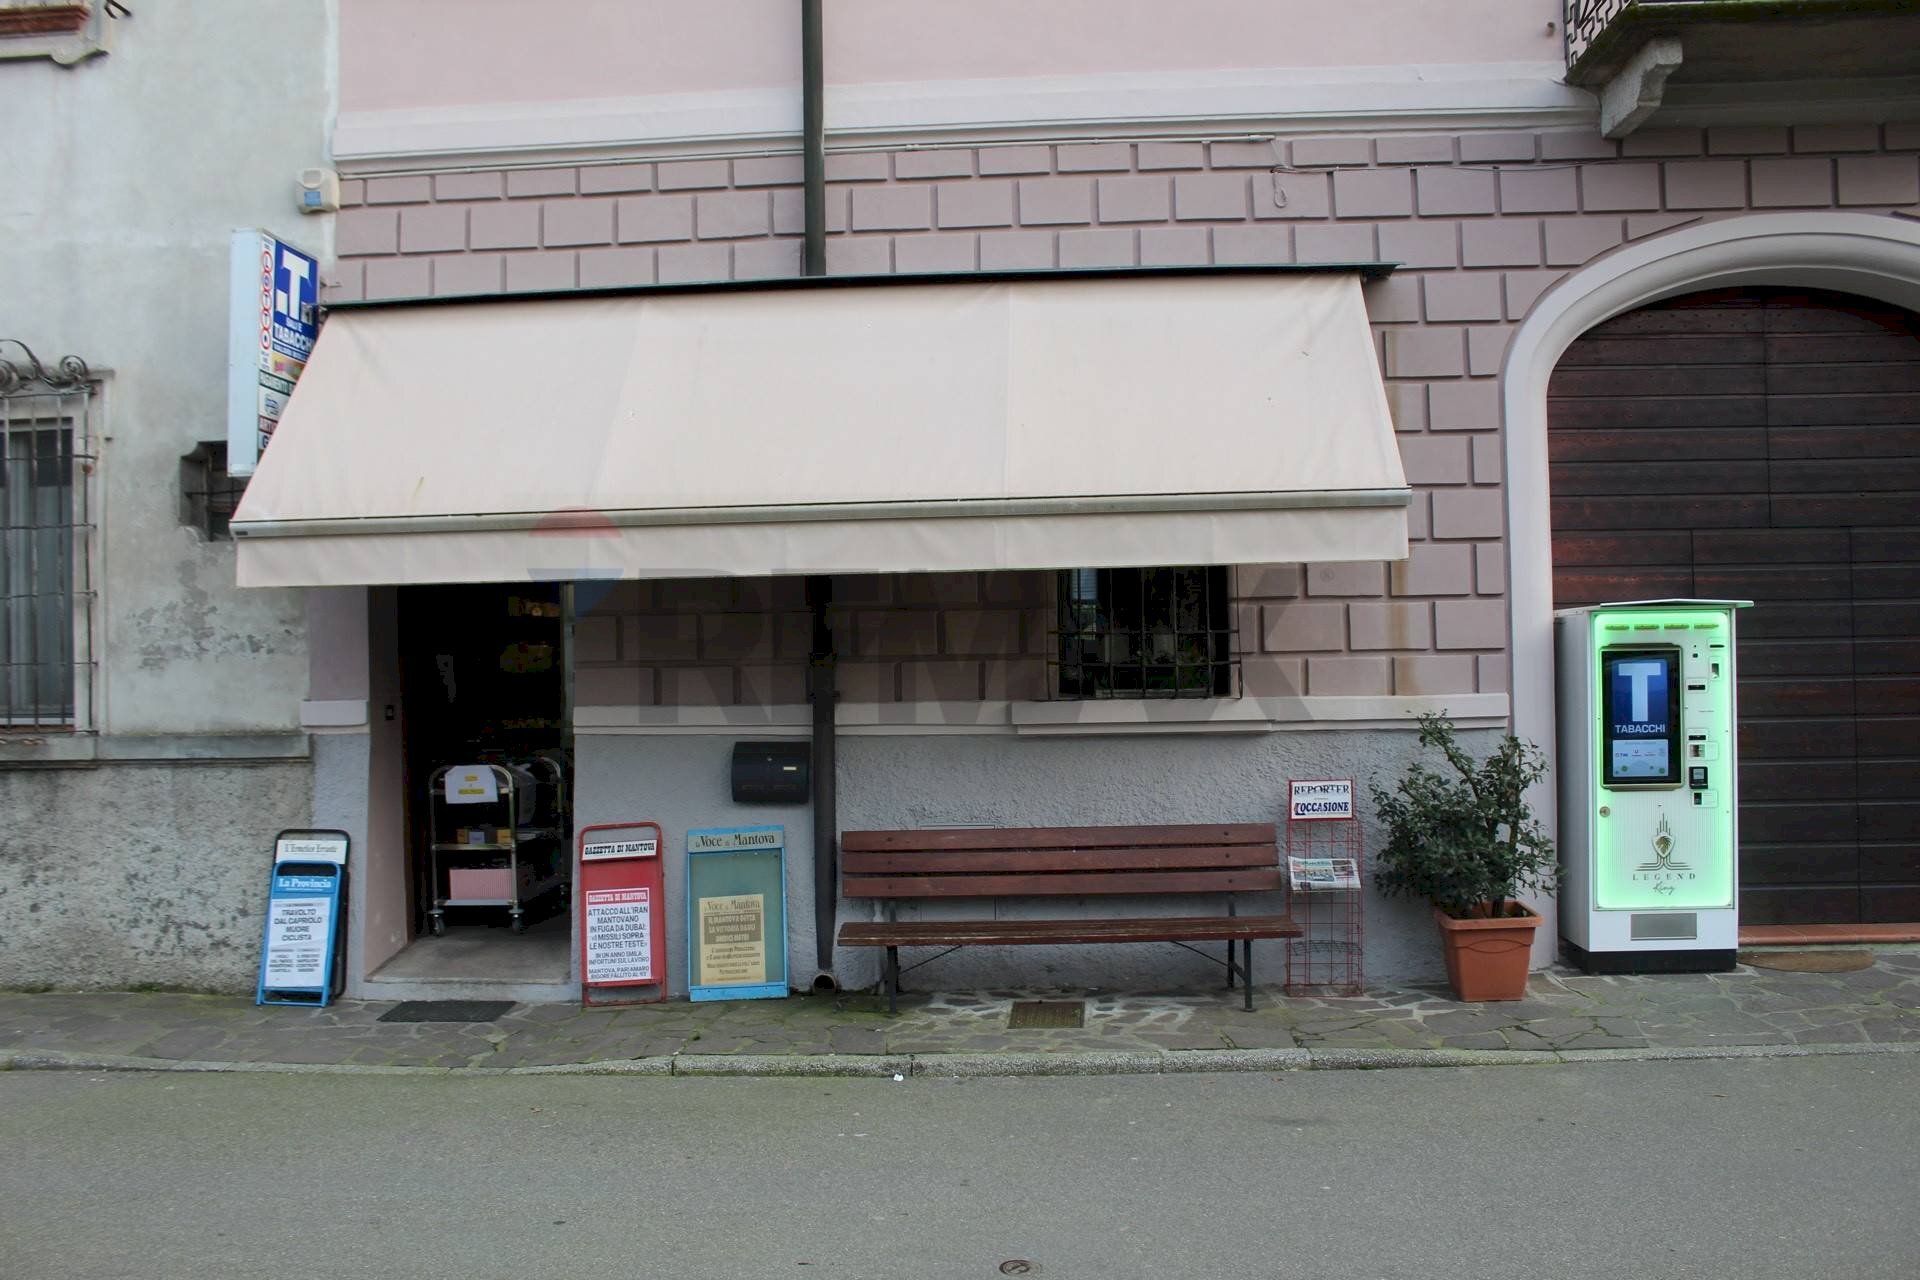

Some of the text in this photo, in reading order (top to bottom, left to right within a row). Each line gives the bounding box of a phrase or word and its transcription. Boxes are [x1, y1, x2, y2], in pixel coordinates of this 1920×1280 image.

[281, 248, 310, 321] T
[274, 322, 312, 351] TABACCH
[1618, 663, 1661, 722] T
[1614, 724, 1666, 734] TABACCHI
[1294, 784, 1350, 796] REPORTER
[700, 835, 722, 847] Voce
[734, 833, 775, 846] Mantova
[585, 843, 655, 856] GAZZETTA DI MANTOVA
[1632, 872, 1696, 881] LEGEND
[278, 878, 332, 888] La Provincia
[1652, 881, 1677, 896] King
[282, 908, 317, 916] TRAVOLTO
[588, 906, 648, 917] ATTACCO ALL'IRAN
[288, 917, 322, 925] CAPRIOLO
[597, 915, 639, 924] MANTOVANO
[598, 925, 615, 933] FUGA
[615, 924, 625, 932] DA
[598, 933, 622, 941] MISSILI
[622, 932, 644, 940] SOPRA
[589, 942, 597, 950] LE
[597, 941, 624, 950] NOSTRE
